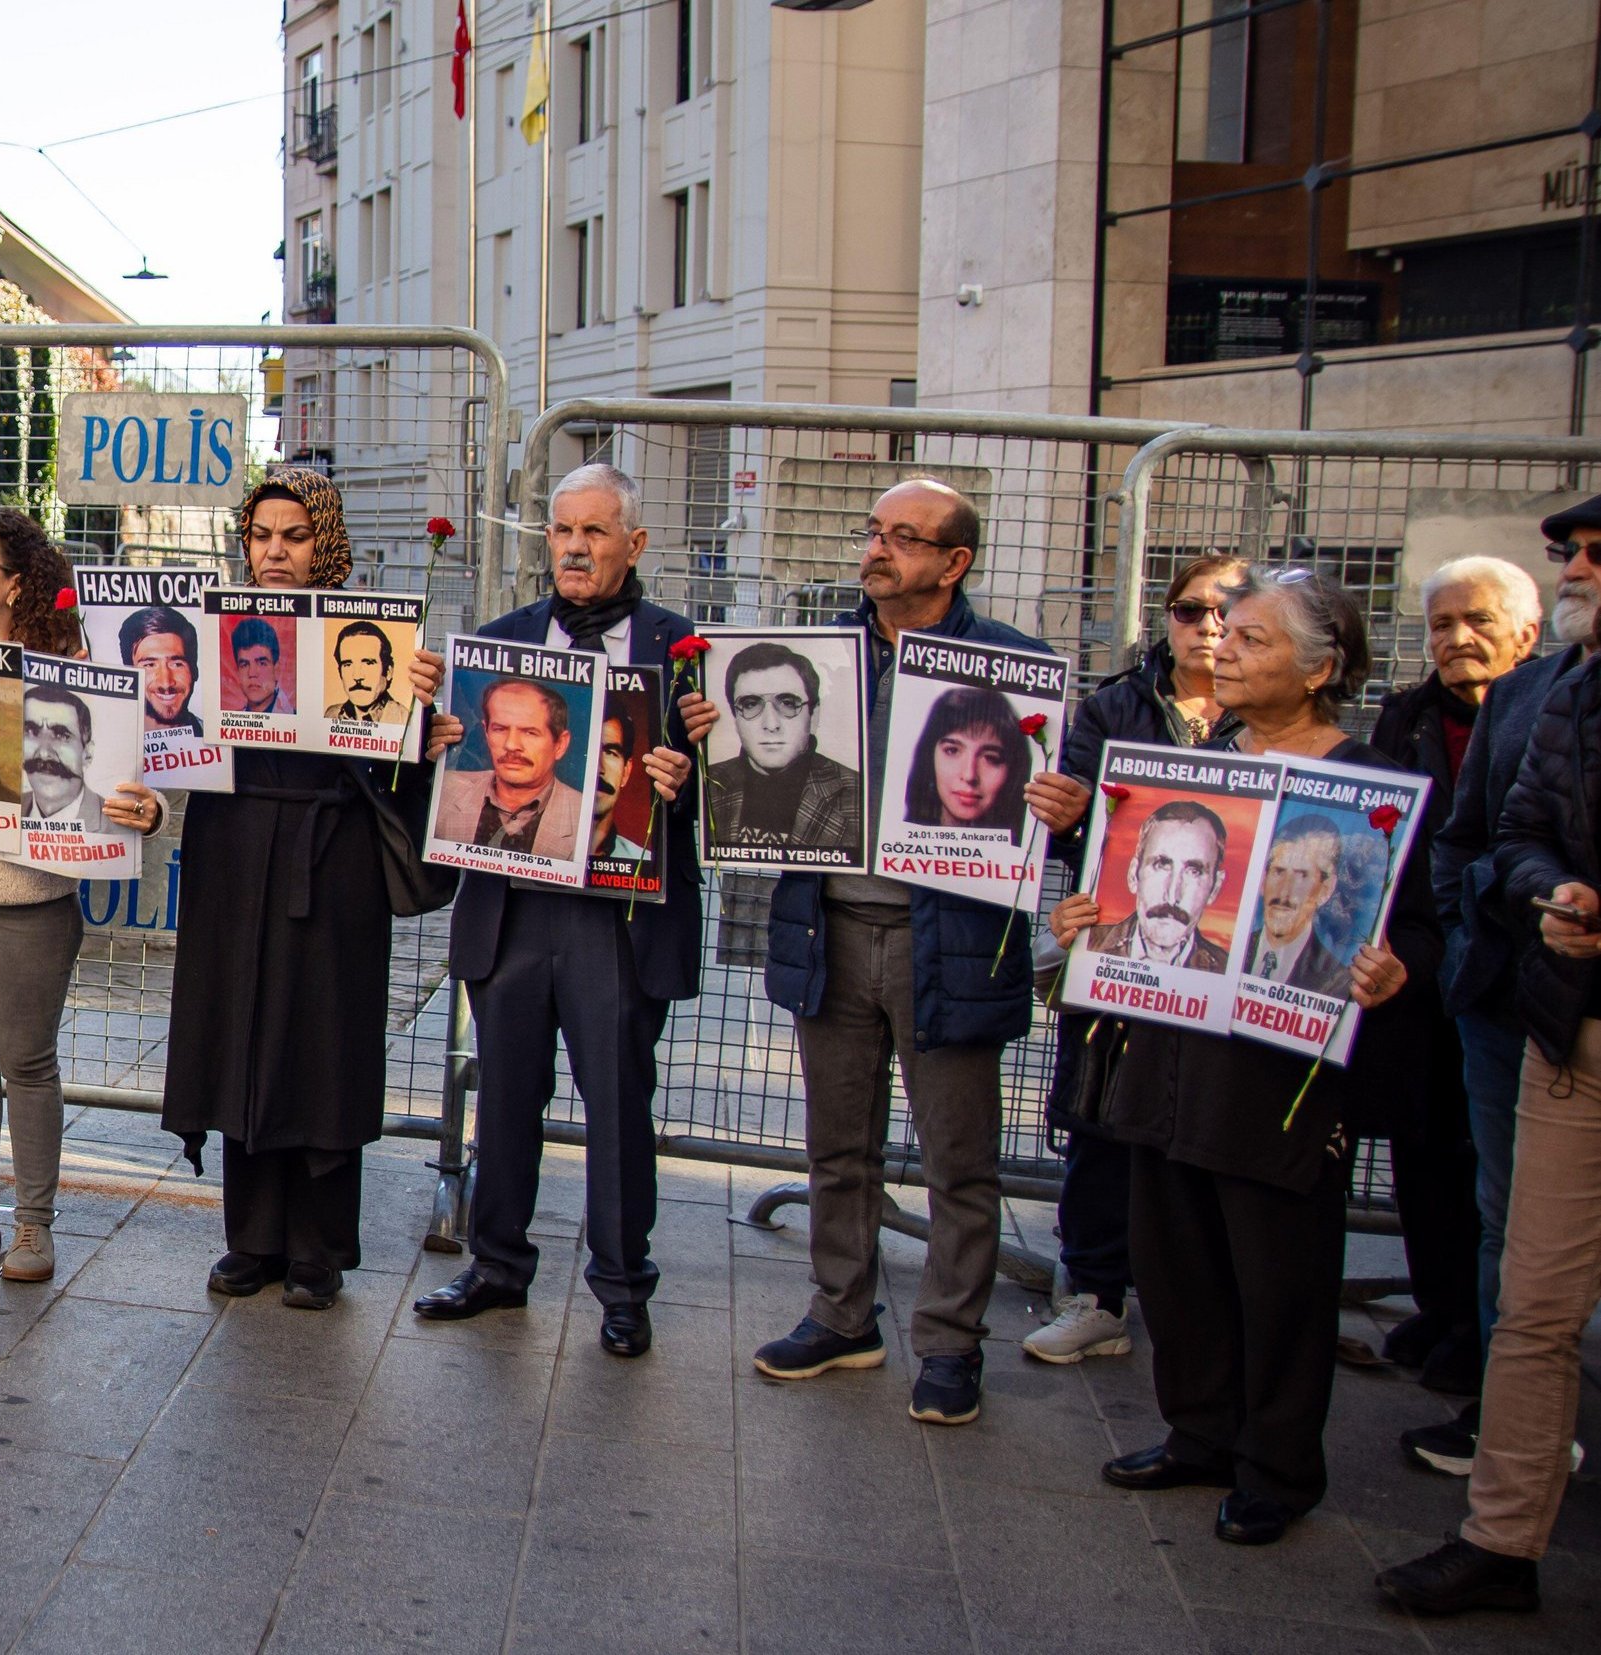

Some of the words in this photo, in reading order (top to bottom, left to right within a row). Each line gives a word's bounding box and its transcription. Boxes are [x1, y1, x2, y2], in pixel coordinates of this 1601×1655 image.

[79, 409, 234, 487] POLİS
[82, 573, 152, 604] HASAN
[221, 597, 252, 612] EDİP
[256, 597, 295, 616] ÇELİK
[323, 598, 378, 617] İBRAHİM
[381, 600, 417, 622] ÇELİK
[454, 645, 515, 675] HALİL
[520, 650, 592, 684] BİRLİK
[902, 644, 987, 677] AYŞENUR
[990, 656, 1064, 691] ŞİMŞEK
[64, 666, 134, 694] GÜLMEZ
[221, 718, 264, 728] GÖZALTINDA
[330, 725, 372, 736] GÖZALTINDA
[220, 727, 297, 744] KAYBEDİLDİ
[1109, 756, 1224, 786] ABDULSELAM
[1227, 767, 1277, 792] ÇELİK
[1358, 788, 1412, 813] ŞAHİN
[28, 831, 85, 844] GÖZALTINDA
[70, 822, 83, 832] DE
[907, 830, 959, 841] 24.01.1995,
[960, 832, 1009, 843] Ankara'da
[29, 841, 126, 863] KAYBEDİLDİ
[455, 843, 462, 852] 7
[465, 845, 504, 859] KASIM
[506, 852, 553, 868] 1996'DA
[710, 846, 783, 860] NURETTİN
[786, 849, 851, 864] YEDİGÖL
[881, 842, 983, 859] GÖZALTINDA
[429, 852, 504, 873] GÖZALTINDA
[506, 865, 578, 885] KAYBEDİLDİ
[592, 861, 632, 873] 1991'DE
[882, 856, 1036, 882] KAYBEDİLDİ
[591, 874, 661, 892] KAYBEDİLDİ
[1105, 958, 1126, 968] Kasım
[1095, 965, 1160, 988] GÖZALTINDA
[1089, 979, 1208, 1021] KAYBEDİLDİ
[1267, 986, 1343, 1016] GÖZALTINDA
[1232, 996, 1331, 1045] YBEDİLDİ
